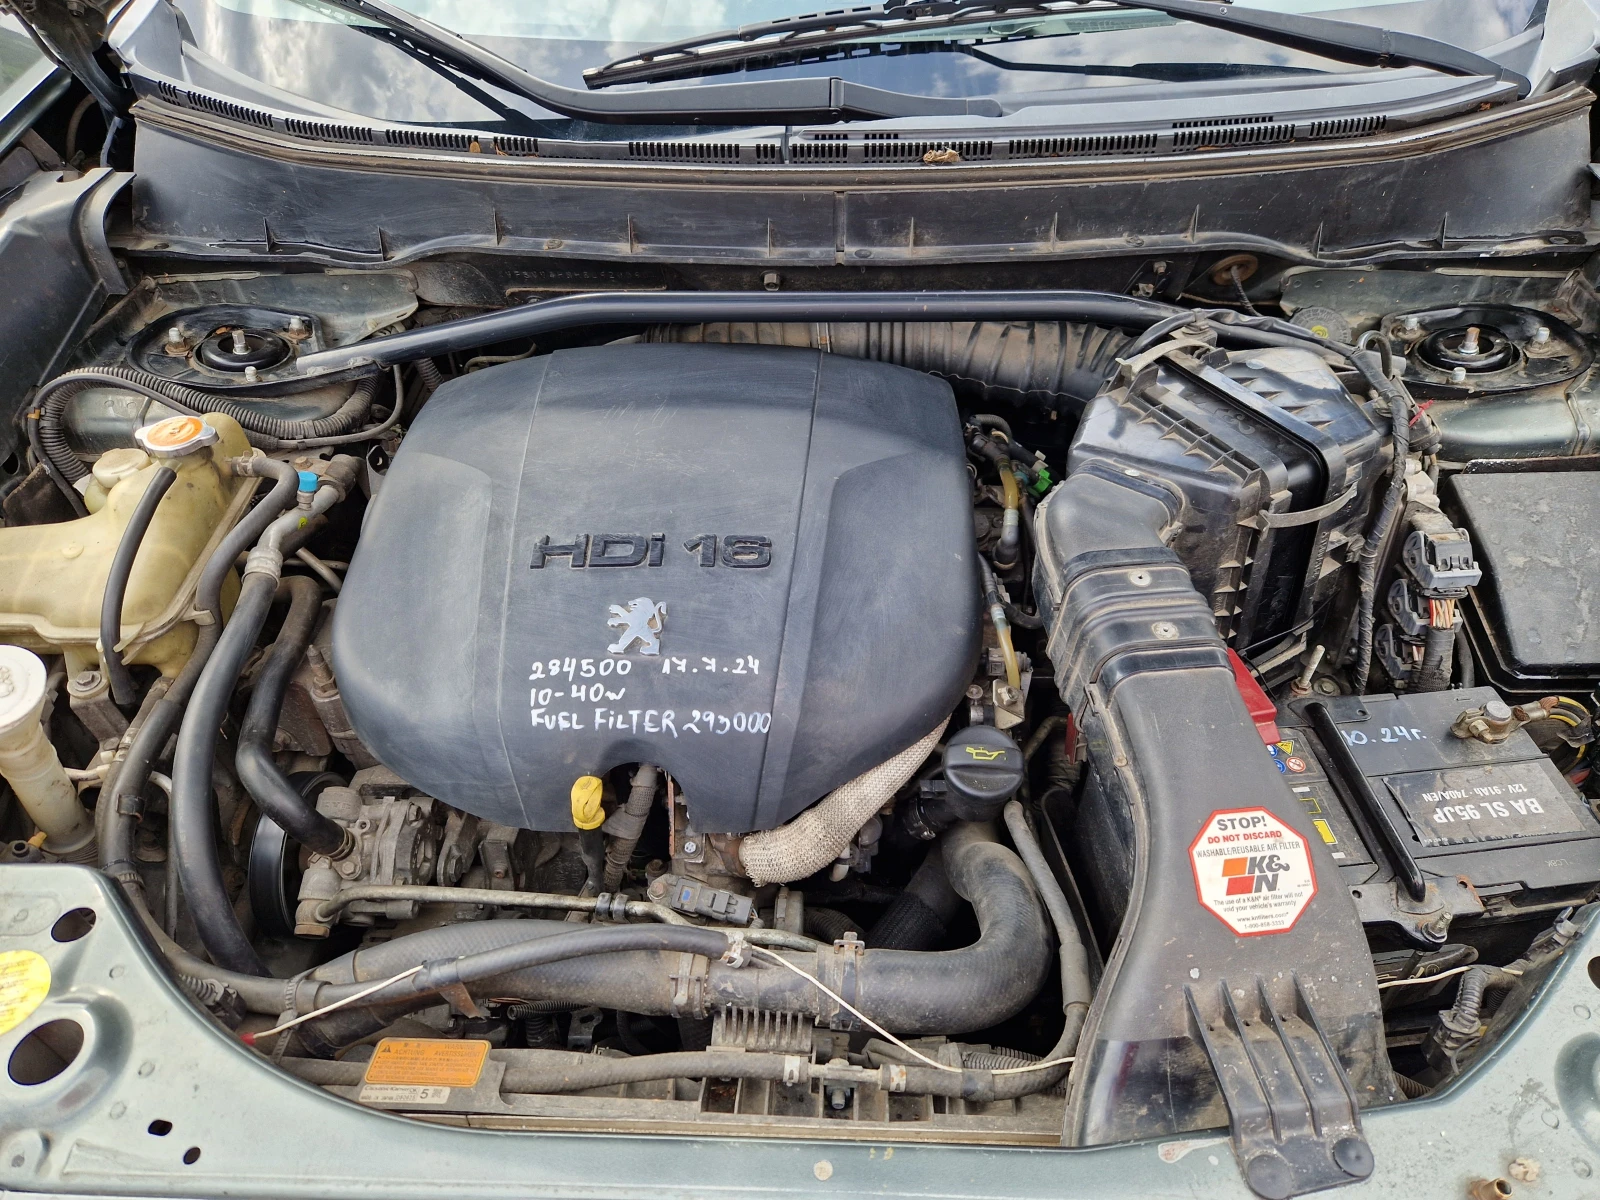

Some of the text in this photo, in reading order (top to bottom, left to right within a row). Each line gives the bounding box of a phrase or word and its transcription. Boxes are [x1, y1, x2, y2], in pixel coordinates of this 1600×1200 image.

[530, 533, 772, 569] HDi 16
[529, 658, 632, 681] 284500
[1473, 785, 1502, 797] 91Ah
[1507, 783, 1528, 794] 12V
[1433, 798, 1544, 823] BA SL 95JP
[1217, 816, 1267, 831] STOP!
[1207, 830, 1282, 844] DO NOT DISCARD
[1196, 841, 1301, 858] WASHABLE/REUSABLE AIR FILTER
[1248, 902, 1272, 910] vehicle's
[1273, 900, 1297, 908] warranty
[419, 1088, 430, 1099] 5
